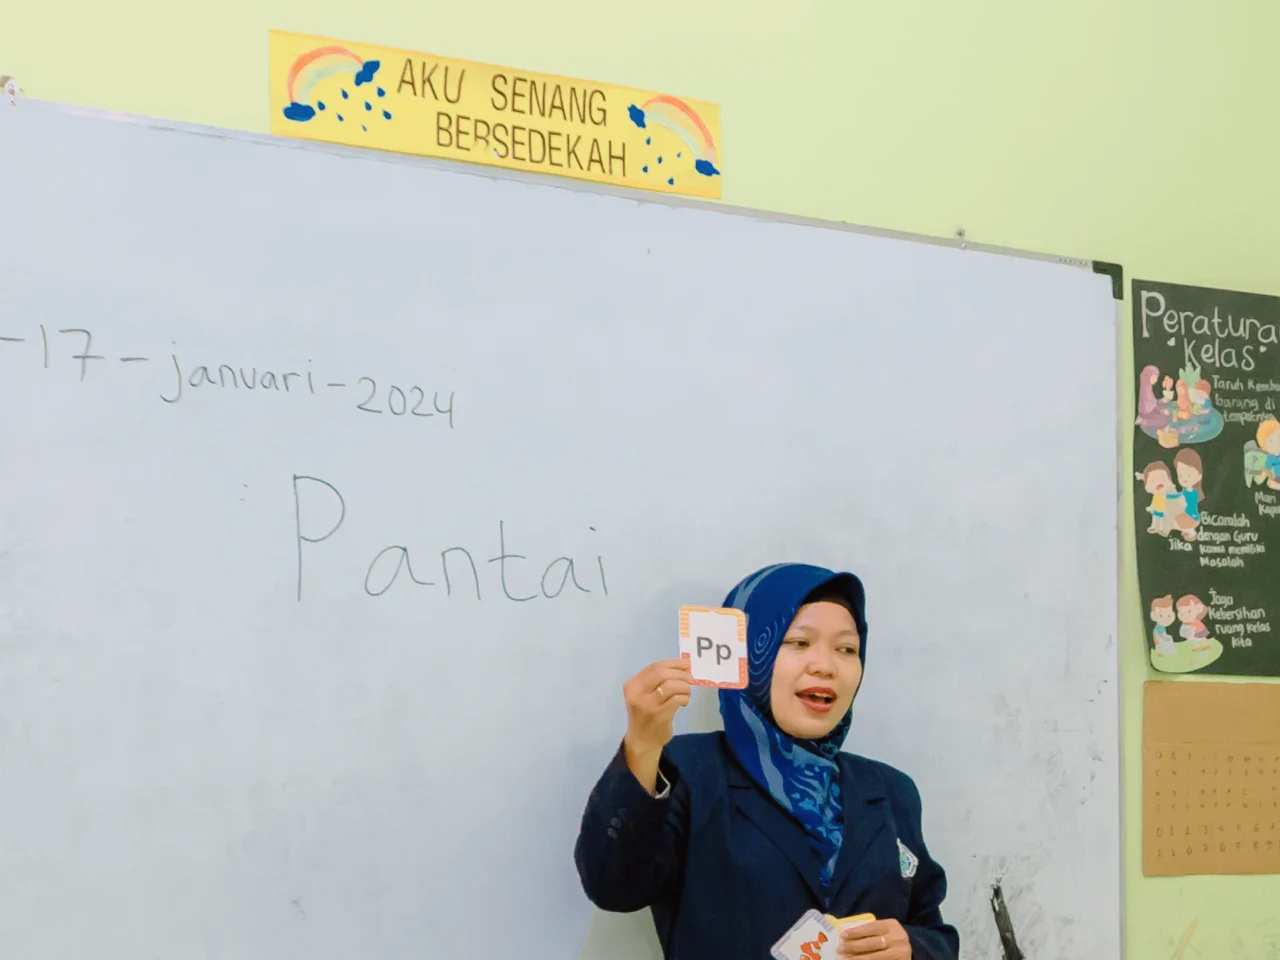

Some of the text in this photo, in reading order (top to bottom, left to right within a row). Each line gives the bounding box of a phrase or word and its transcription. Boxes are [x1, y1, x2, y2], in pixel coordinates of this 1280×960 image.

[396, 57, 608, 127] AKU SENANG
[435, 111, 627, 178] BERSEDEKAH
[1184, 338, 1256, 371] Kelas
[1212, 374, 1244, 391] Taruh
[1215, 392, 1276, 411] barang di
[292, 473, 610, 602] Pantai
[1197, 526, 1232, 544] dengan
[1215, 623, 1245, 637] ruang
[695, 635, 732, 666] Pp
